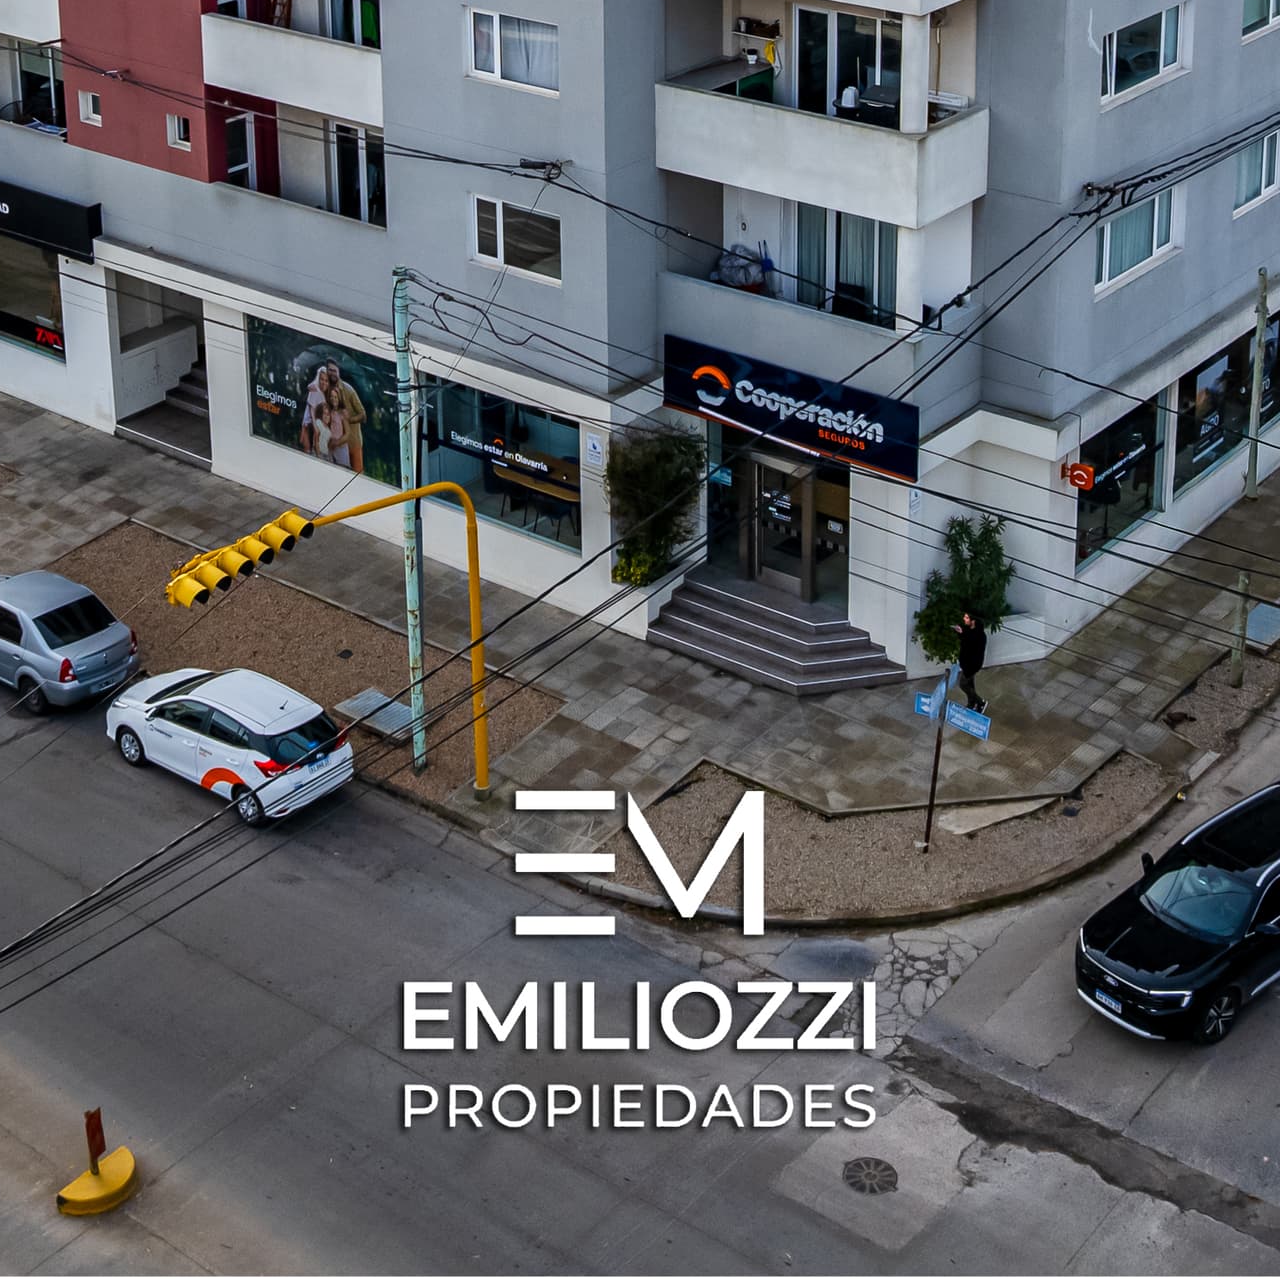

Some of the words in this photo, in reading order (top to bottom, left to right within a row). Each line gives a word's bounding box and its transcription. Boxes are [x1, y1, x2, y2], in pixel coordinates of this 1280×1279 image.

[256, 384, 297, 408] Elegimos
[735, 380, 884, 443] Cooperación
[451, 431, 483, 449] Elegimos
[483, 444, 503, 456] estar
[504, 451, 515, 460] en
[818, 429, 865, 450] SEGUROS
